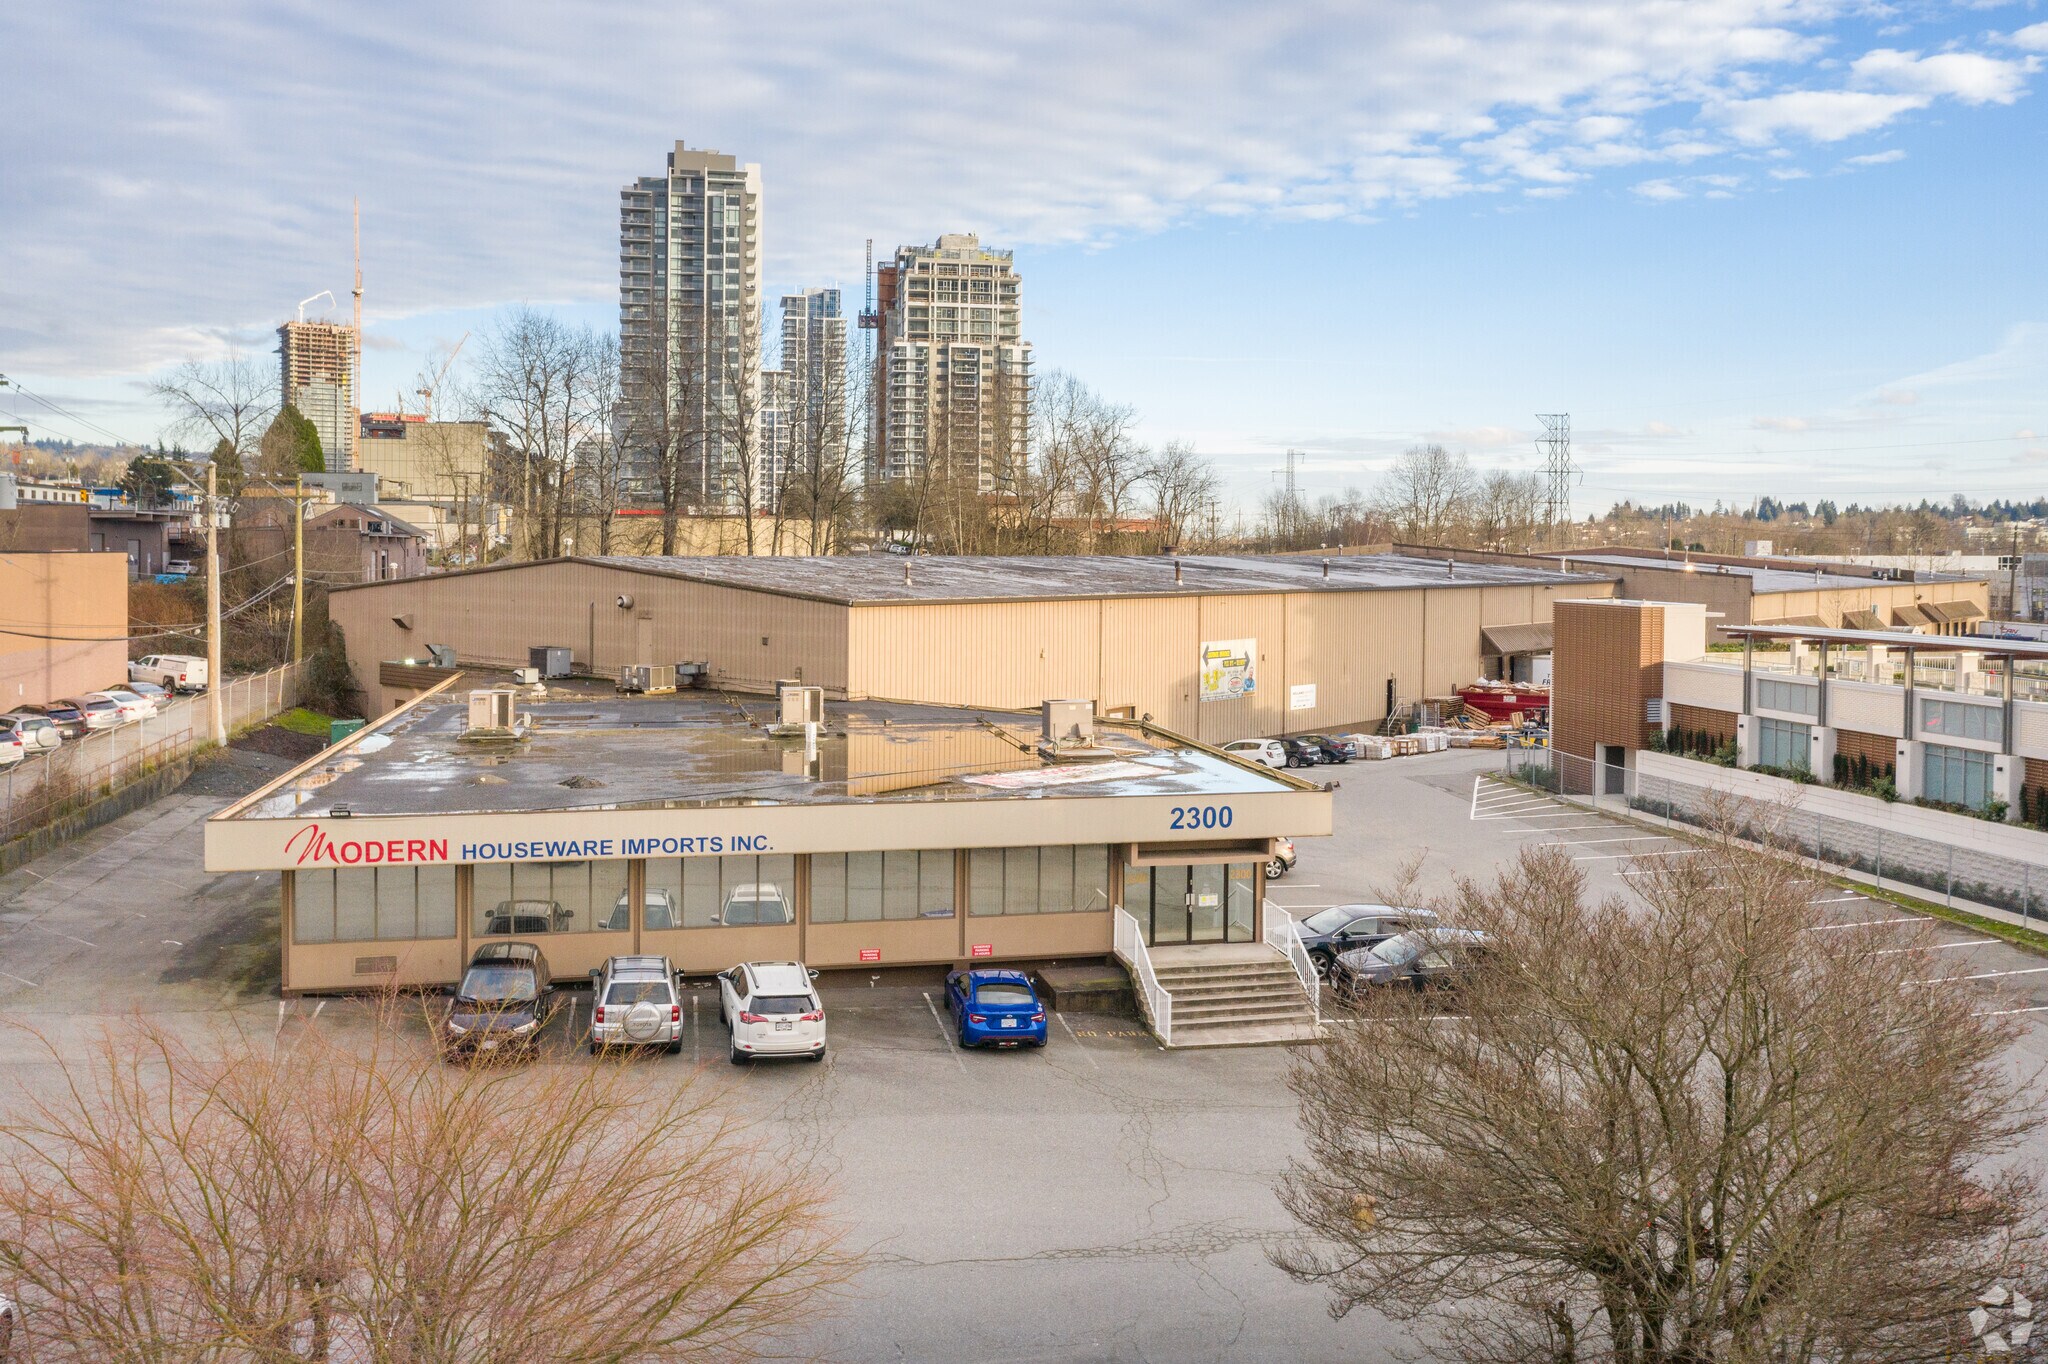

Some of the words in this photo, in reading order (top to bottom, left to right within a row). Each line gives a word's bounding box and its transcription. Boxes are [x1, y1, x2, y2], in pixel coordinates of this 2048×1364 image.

[1170, 806, 1233, 829] 2300
[284, 824, 448, 865] MODERN
[462, 839, 614, 860] HOUSEWARE
[621, 836, 724, 855] IMPORTS
[731, 834, 774, 852] INC.
[1231, 869, 1250, 880] 2300
